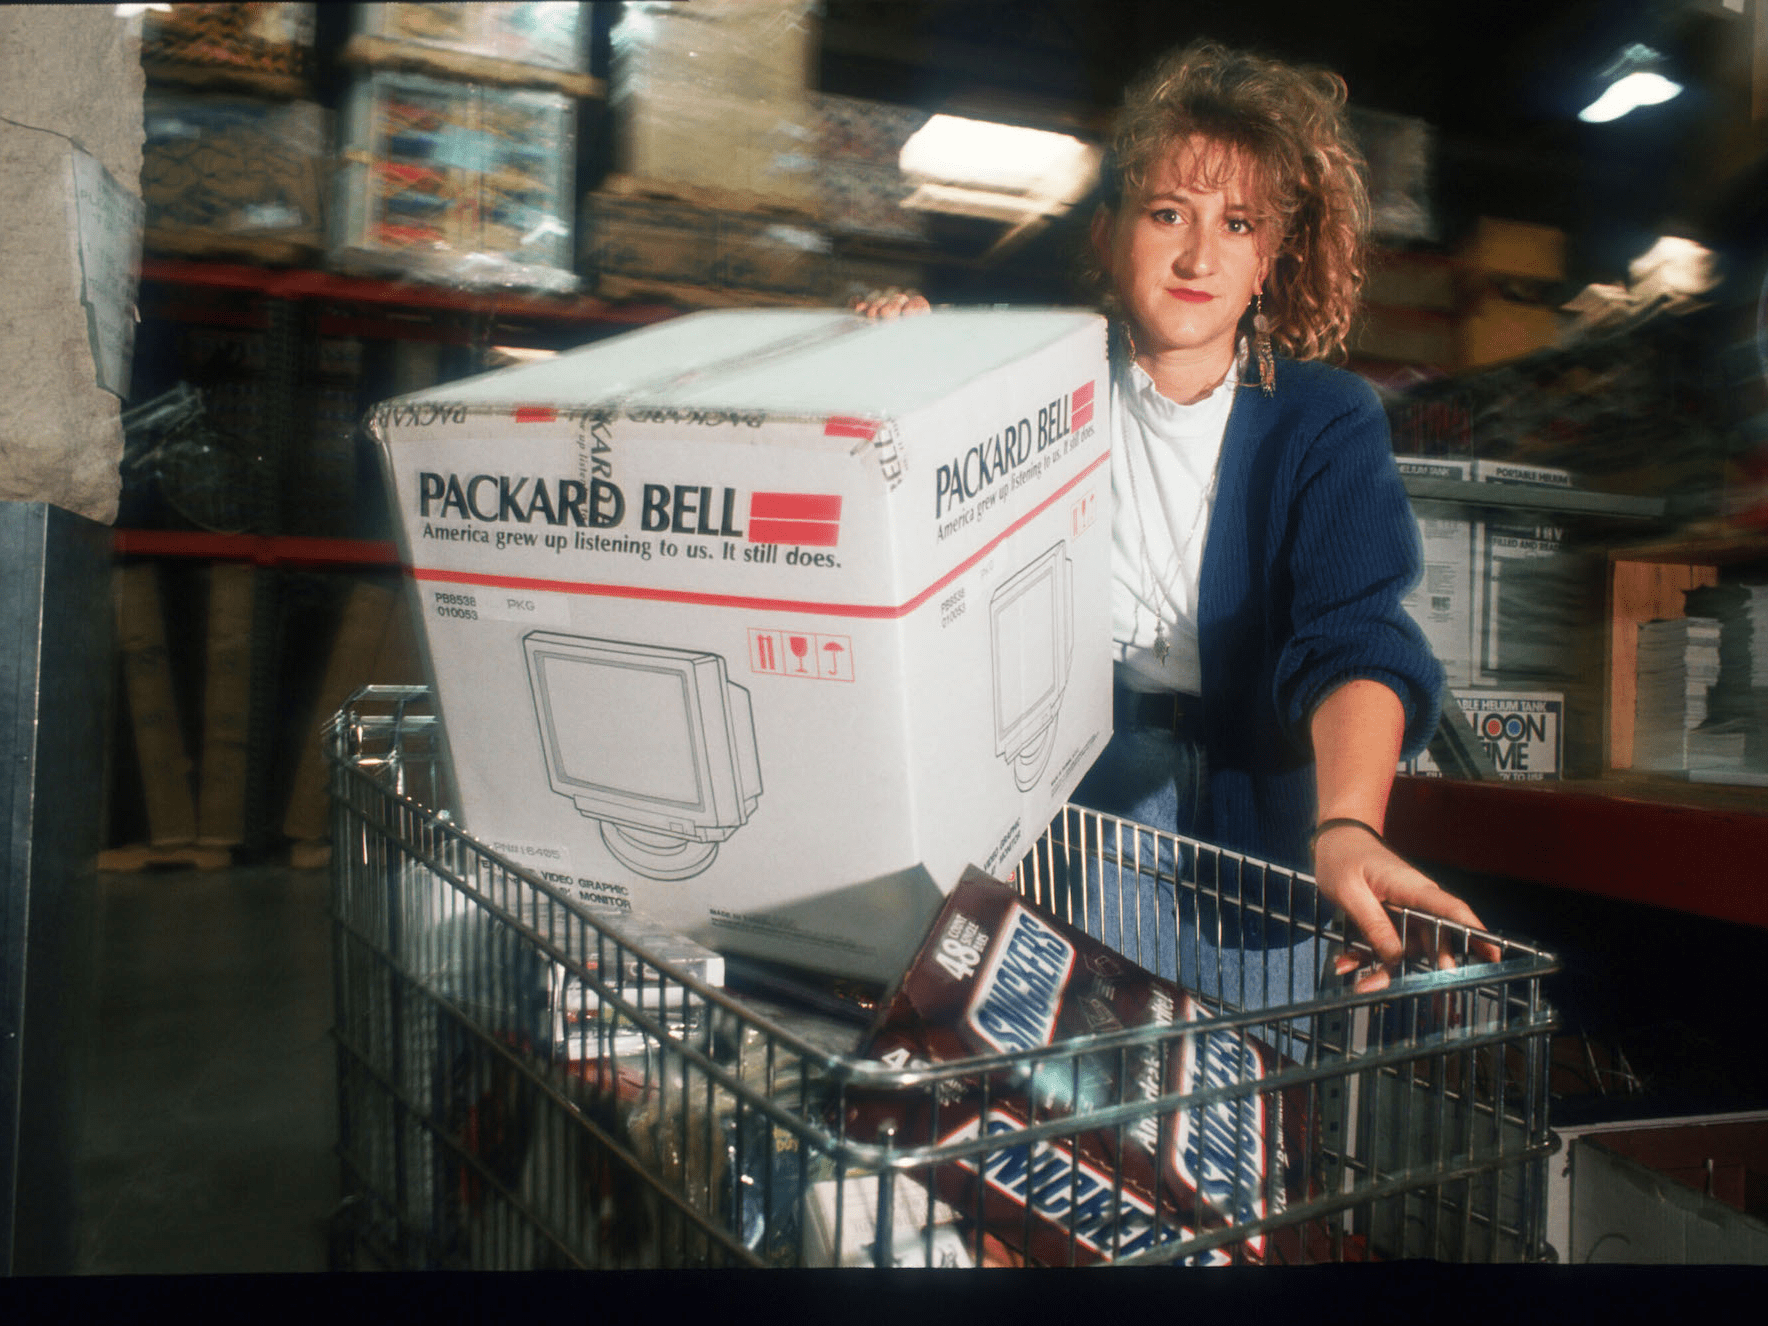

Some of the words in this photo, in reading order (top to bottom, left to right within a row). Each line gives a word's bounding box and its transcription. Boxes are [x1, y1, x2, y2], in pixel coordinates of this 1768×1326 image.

[936, 417, 1032, 520] PACKARD
[1037, 393, 1070, 453] BELL
[936, 508, 975, 544] America
[976, 491, 996, 522] grew
[998, 484, 1010, 502] up
[1010, 459, 1042, 492] listening
[1069, 430, 1080, 451] still
[1496, 467, 1536, 482] PORTABLE
[419, 471, 626, 529] PACKARD
[641, 483, 744, 537] BELL
[423, 521, 490, 543] America
[496, 531, 539, 549] grew
[545, 534, 568, 554] up
[574, 531, 652, 560] listening
[659, 538, 678, 557] to
[686, 541, 714, 560] us.
[722, 541, 736, 561] It
[743, 543, 778, 564] still
[786, 546, 843, 568] does.
[437, 604, 479, 621] 010053
[507, 598, 536, 612] PKG
[1481, 700, 1519, 712] HELIUM
[1520, 701, 1547, 712] TANK
[540, 869, 574, 886] VIDEO
[578, 878, 630, 897] GRAPHIC
[578, 891, 632, 910] MONITOR
[936, 938, 981, 981] 48
[976, 912, 1070, 1052] SNICKERS
